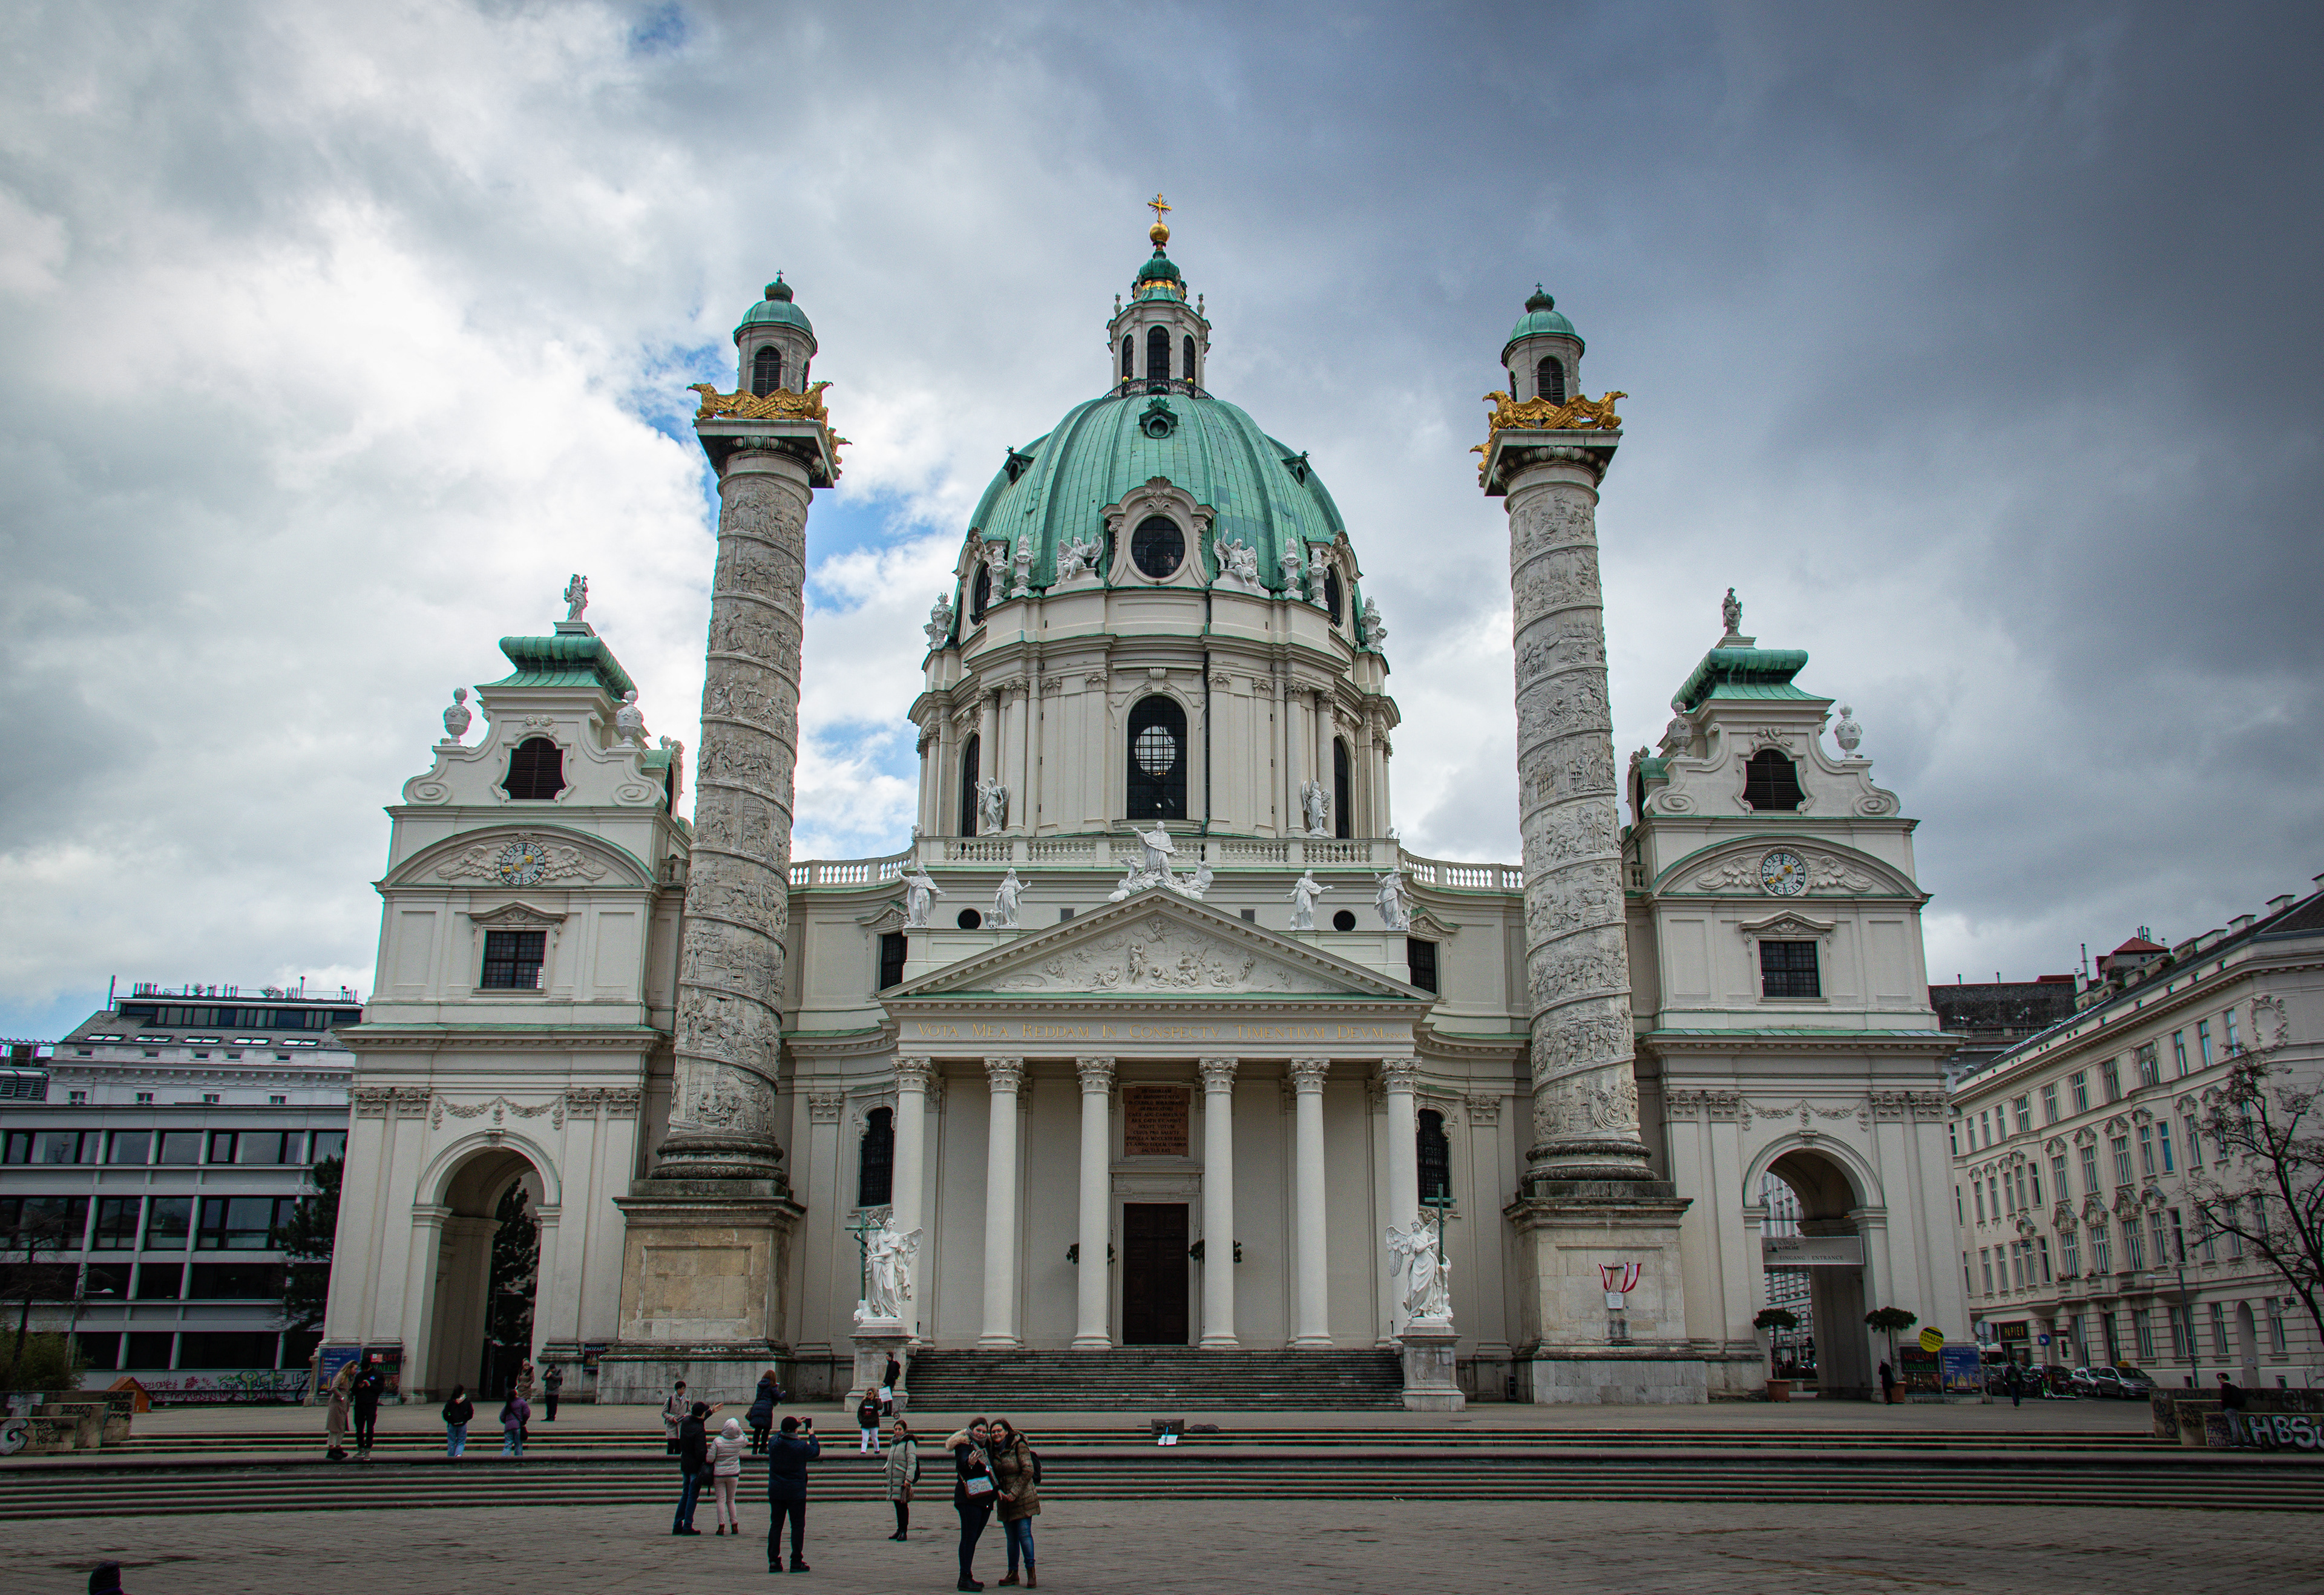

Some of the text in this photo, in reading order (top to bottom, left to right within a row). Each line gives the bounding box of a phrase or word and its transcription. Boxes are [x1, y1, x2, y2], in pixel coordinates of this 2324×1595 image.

[917, 1023, 959, 1037] VOTA
[972, 1023, 1009, 1038] MEA
[1022, 1023, 1090, 1038] REDDAM
[1102, 1024, 1117, 1038] IN
[1129, 1024, 1221, 1038] CONSPECTV
[1233, 1024, 1325, 1039] TIMENTIVM
[1337, 1024, 1384, 1039] DEVM
[1920, 1331, 1943, 1344] VIVALDI
[2004, 1326, 2024, 1337] PAPIER
